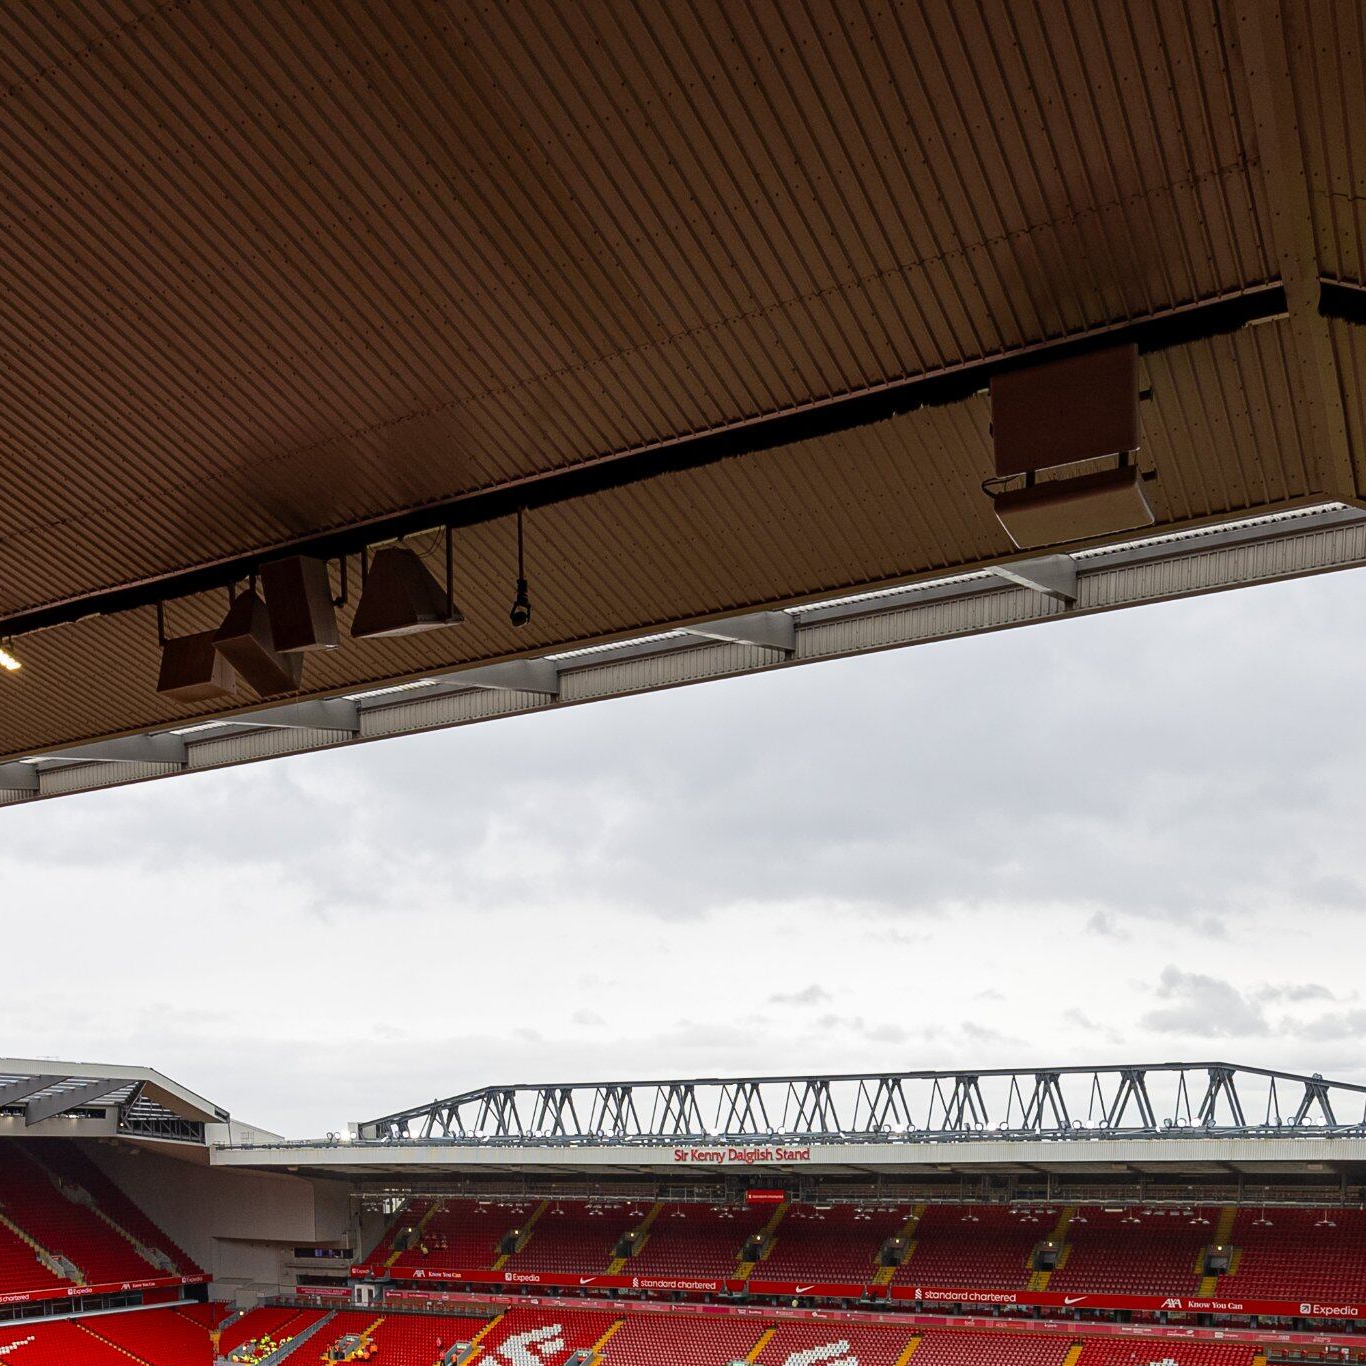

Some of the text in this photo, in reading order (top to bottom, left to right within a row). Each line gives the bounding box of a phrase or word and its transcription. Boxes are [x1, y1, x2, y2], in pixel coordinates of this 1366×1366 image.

[674, 1148, 810, 1164] Sir Kenny Dalglish Stand
[413, 1269, 425, 1278] AXA
[512, 1273, 540, 1284] Expedia
[640, 1279, 716, 1290] standard chartered
[3, 1294, 29, 1303] chartered
[924, 1290, 1017, 1303] standard chartered
[1161, 1298, 1243, 1310] AXA Know You Can
[1313, 1304, 1358, 1316] Expedia
